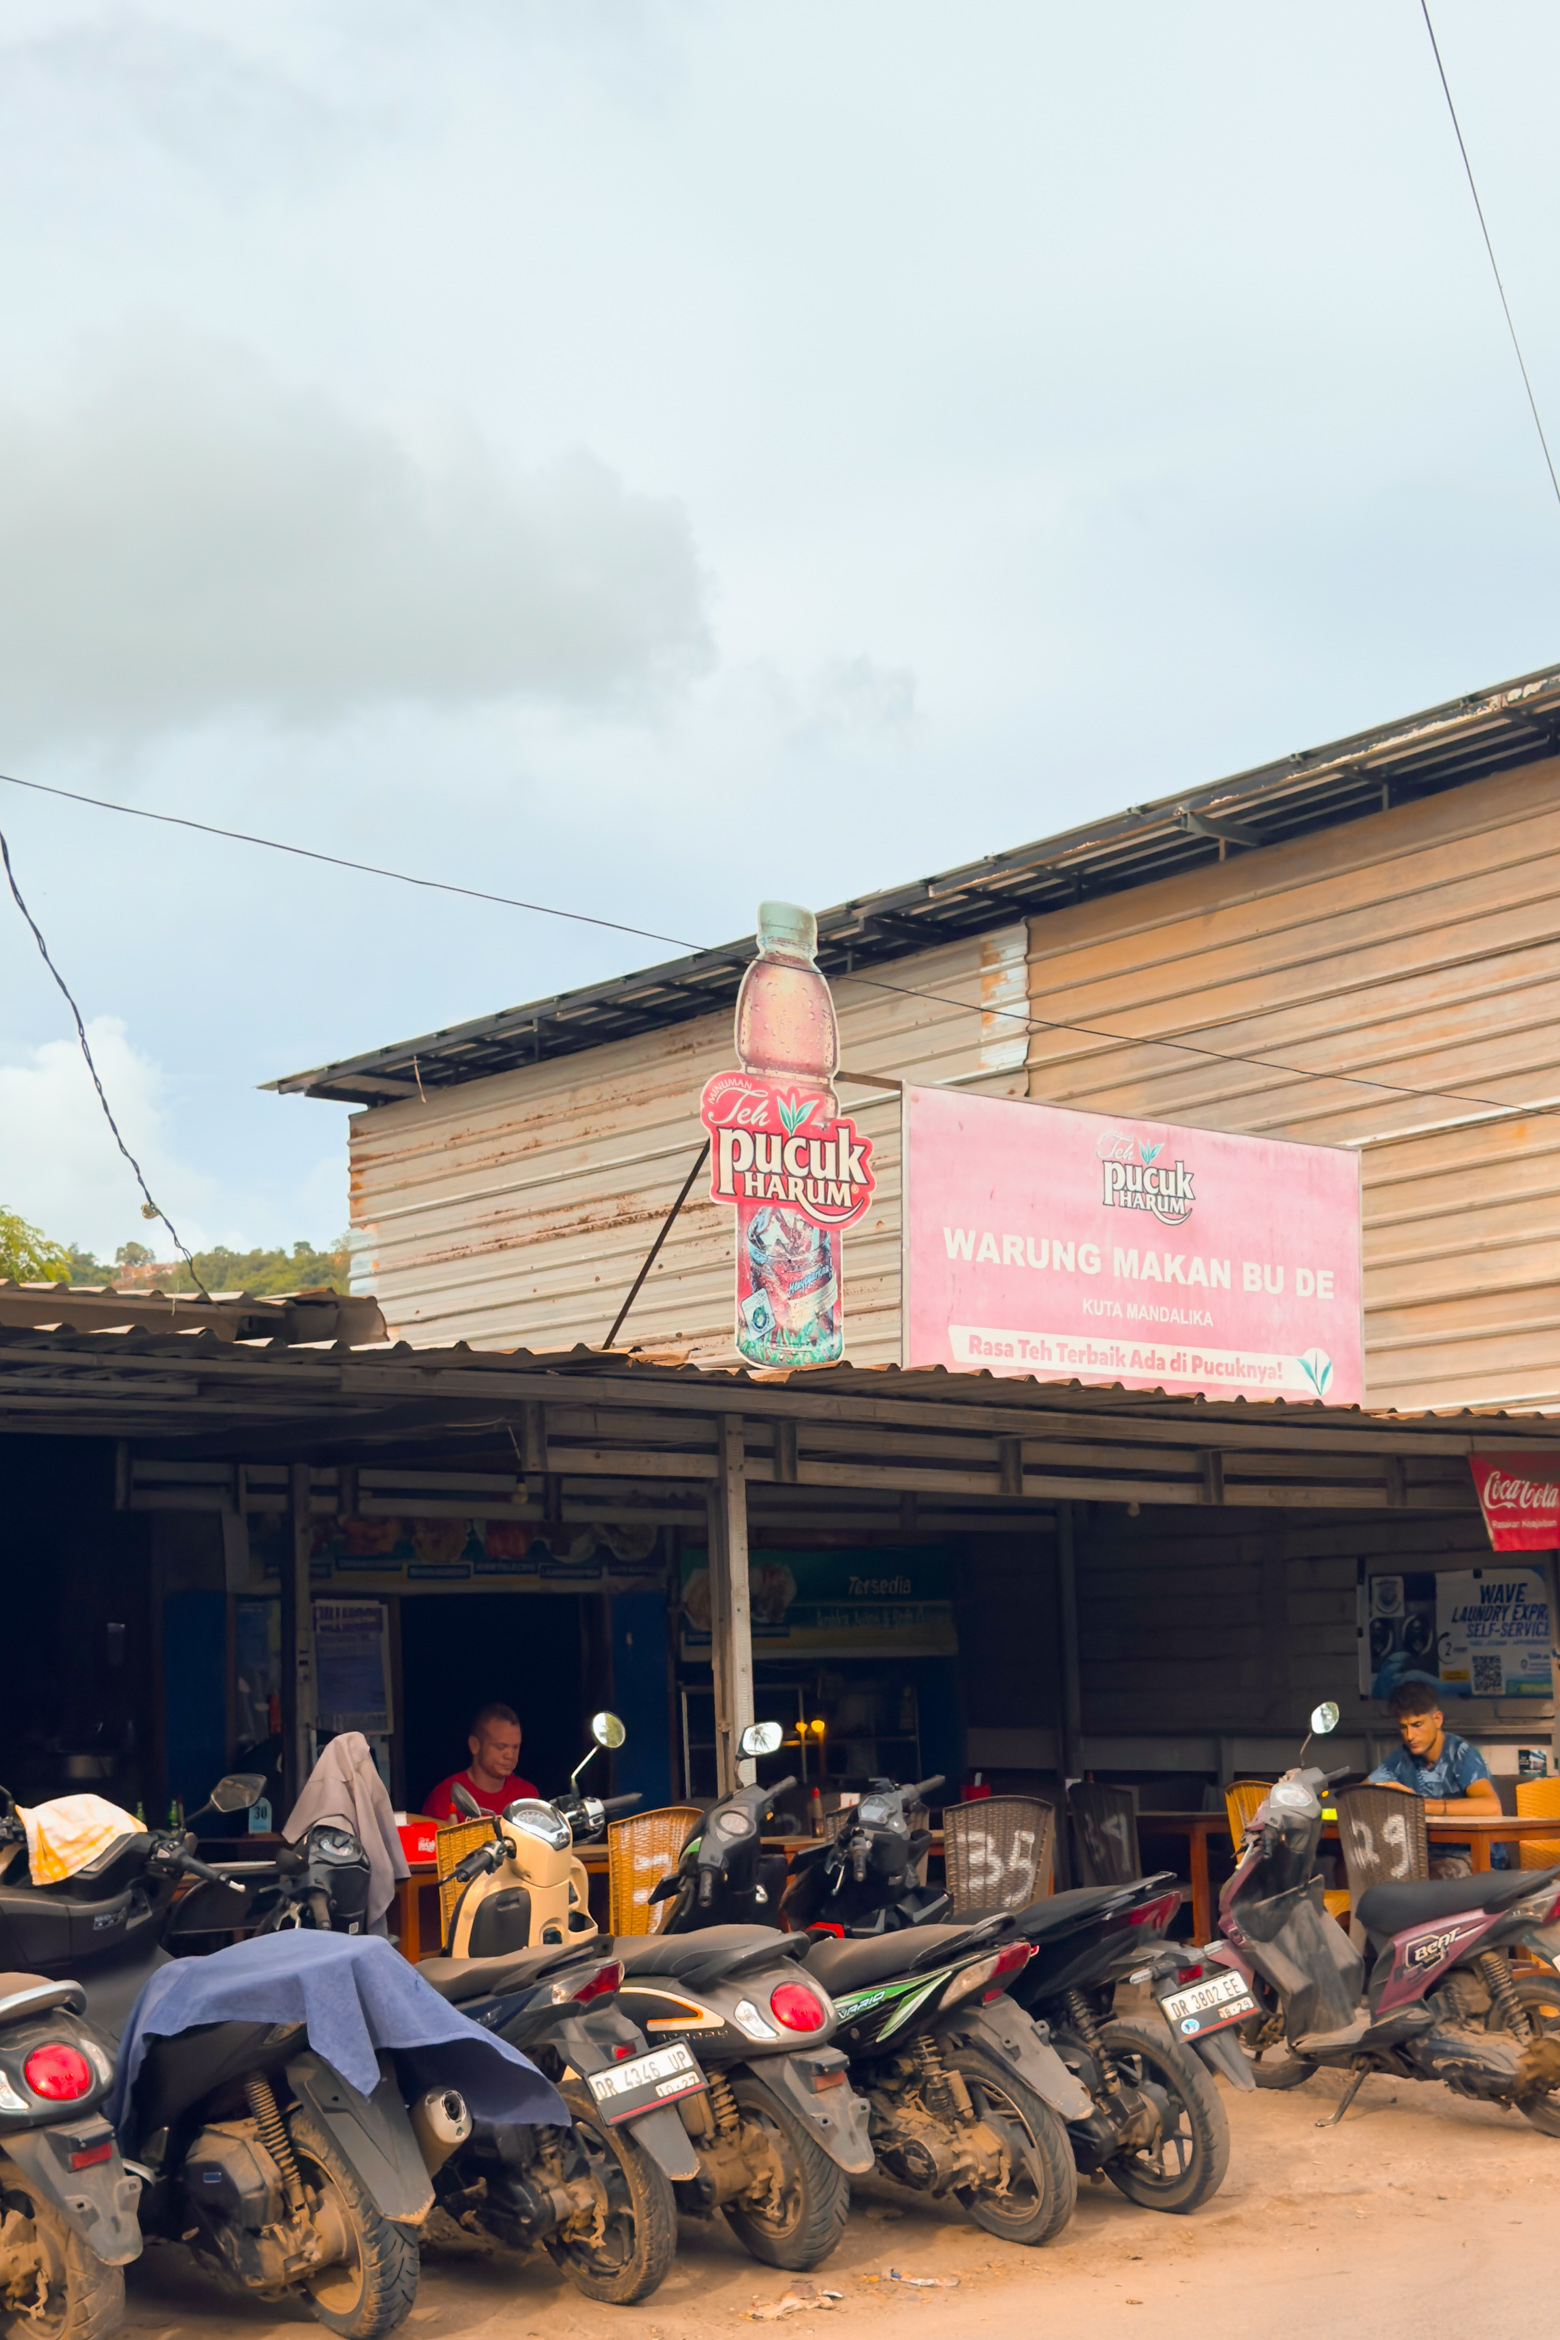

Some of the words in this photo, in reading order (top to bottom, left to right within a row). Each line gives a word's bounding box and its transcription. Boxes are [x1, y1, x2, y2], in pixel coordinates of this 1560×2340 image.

[707, 1078, 753, 1105] MINUMAN
[707, 1086, 771, 1127] Teh
[1096, 1132, 1134, 1160] Teh
[743, 1171, 864, 1224] HARUM
[1119, 1190, 1193, 1226] HARUM
[943, 1226, 1101, 1275] WARUNG
[1113, 1247, 1231, 1290] MAKAN
[1242, 1261, 1284, 1295] BU
[1295, 1267, 1335, 1300] DE
[1082, 1298, 1123, 1318] KUTA
[1126, 1303, 1214, 1328] MANDALIKA
[968, 1334, 1014, 1358] Rasa
[1017, 1338, 1052, 1362] Teh
[1056, 1342, 1126, 1368] Terbaik
[1129, 1349, 1166, 1372] Ada
[1170, 1352, 1187, 1373] di
[1192, 1355, 1284, 1384] Pucuknya!
[1480, 1582, 1528, 1604] WAVE
[1451, 1604, 1511, 1623] LAUNDRY
[1512, 1603, 1549, 1621] EXPR
[253, 1805, 268, 1820] 30
[837, 1990, 886, 2019] VARIO
[1170, 1999, 1190, 2018] DR
[1190, 1985, 1223, 2010] 3802
[1222, 1978, 1241, 1997] EE
[595, 2076, 619, 2099] DR
[624, 2061, 661, 2089] 4346
[667, 2050, 687, 2071] UP
